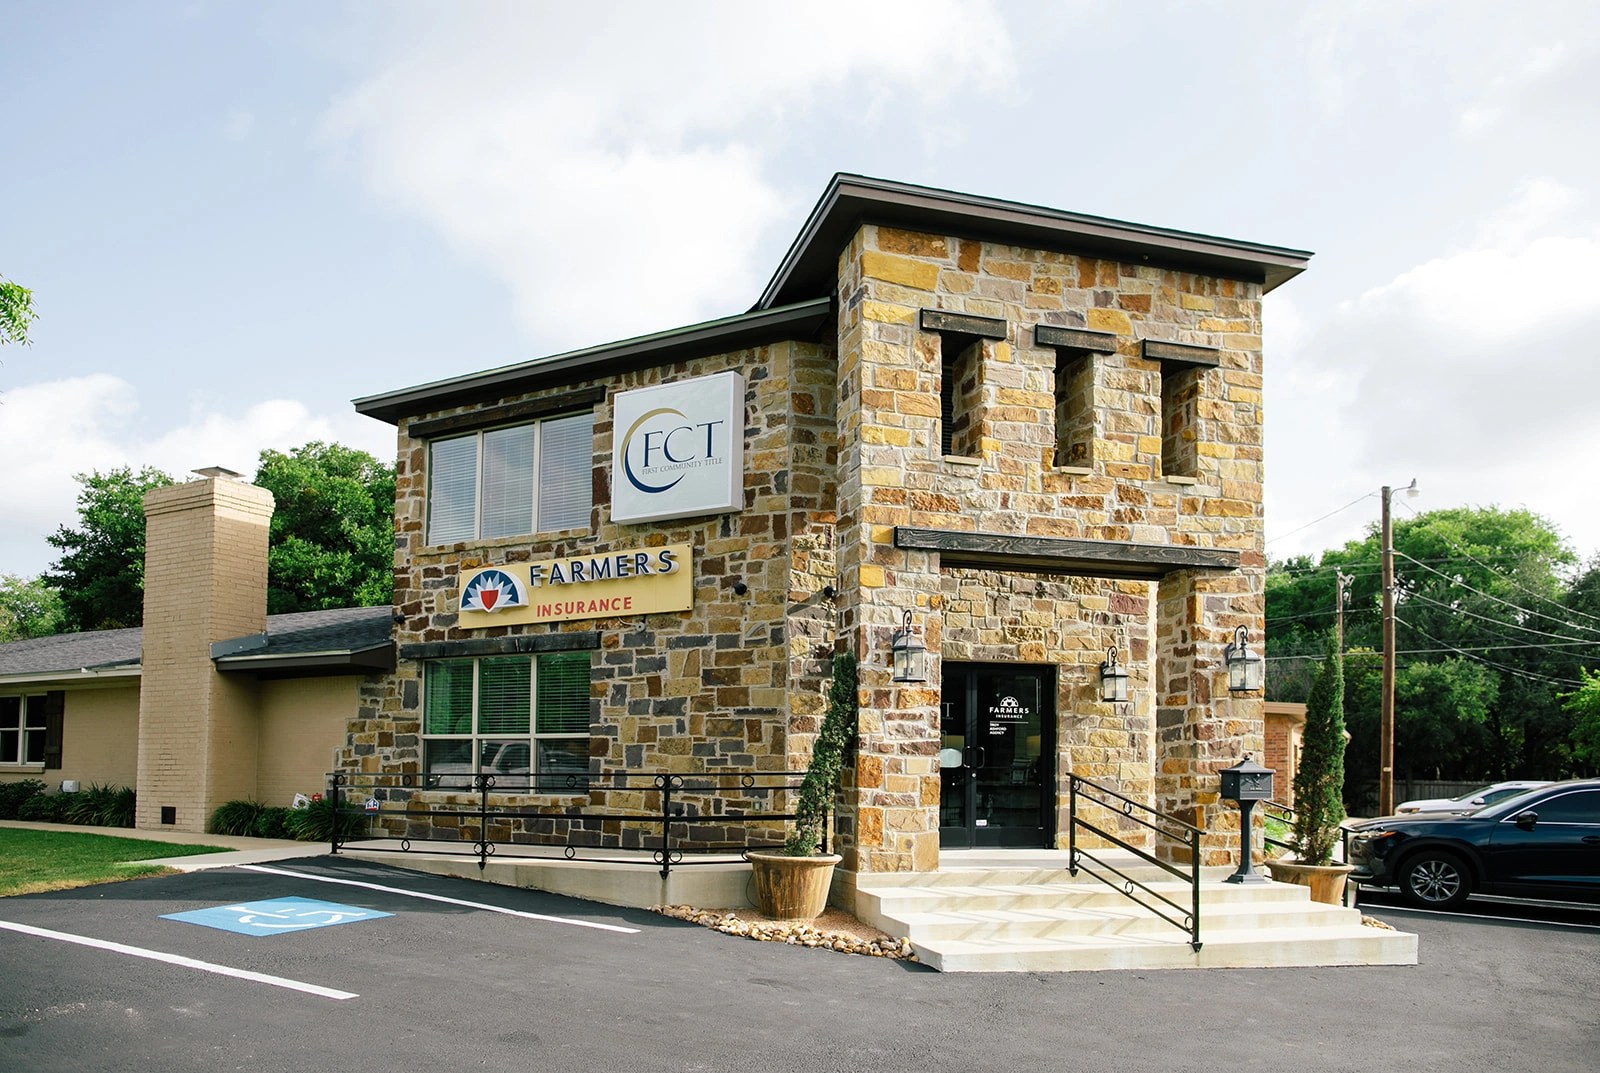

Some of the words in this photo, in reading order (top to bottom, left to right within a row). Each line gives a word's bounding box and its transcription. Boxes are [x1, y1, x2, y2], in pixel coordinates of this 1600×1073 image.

[643, 420, 724, 468] FCT
[642, 466, 659, 475] FIRST
[660, 460, 703, 473] COMMUNITY
[704, 457, 723, 466] TITLE
[529, 550, 676, 587] FARMERS
[536, 596, 632, 617] INSURANCE
[989, 706, 1030, 714] FARMERS
